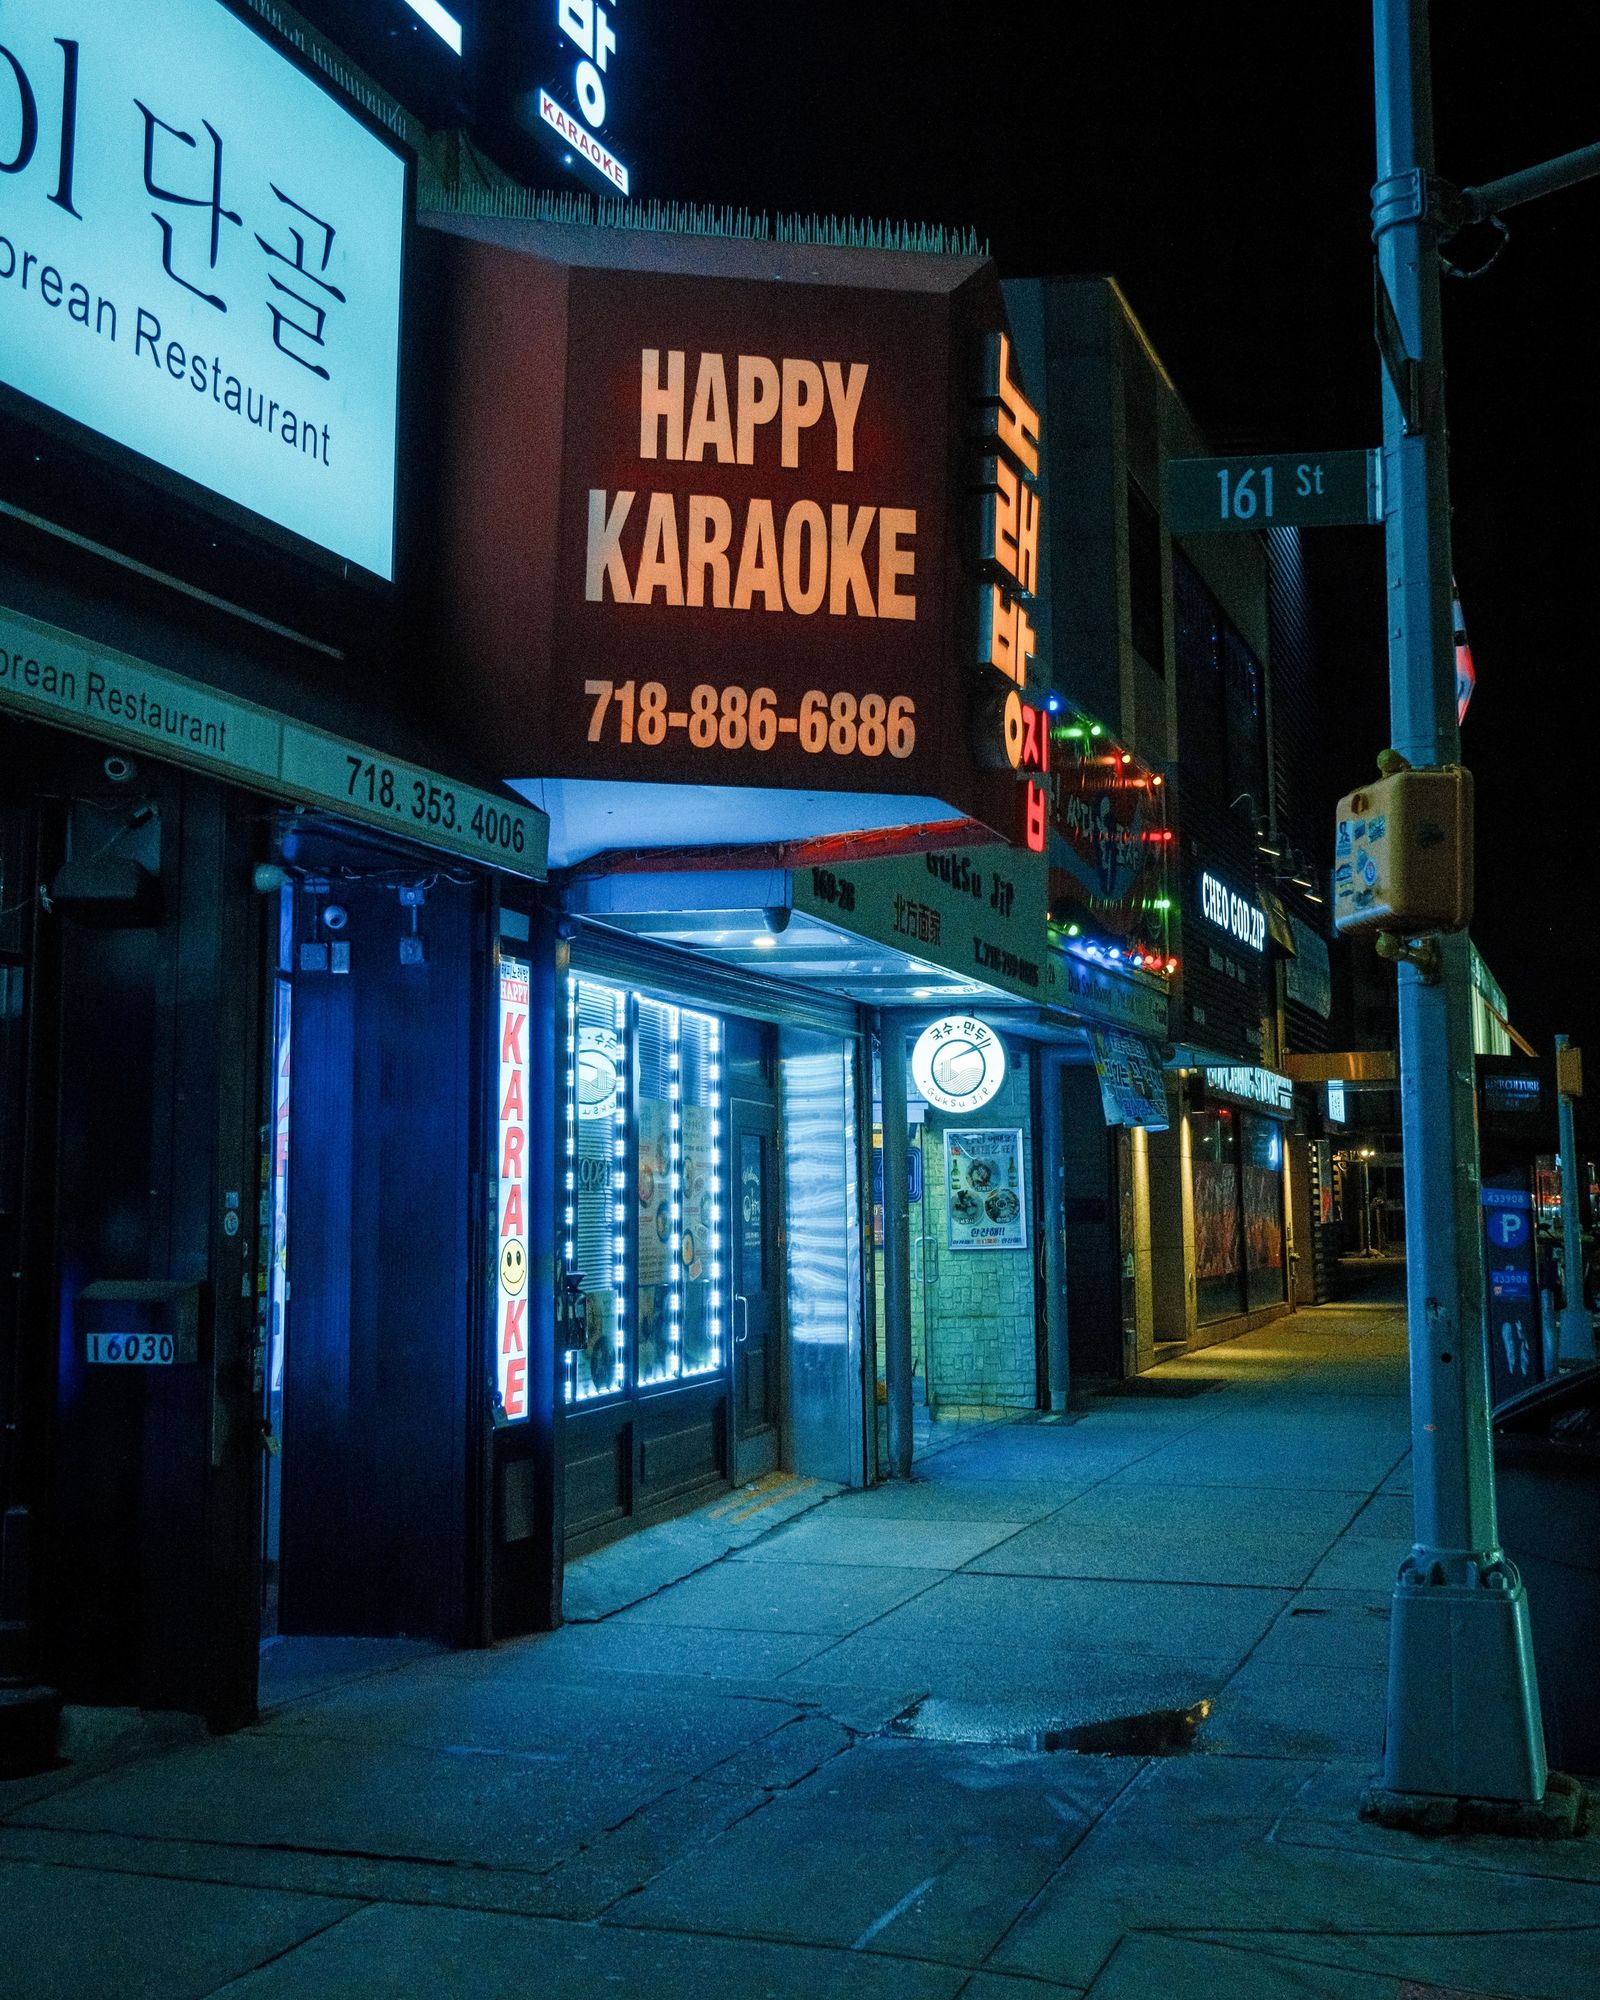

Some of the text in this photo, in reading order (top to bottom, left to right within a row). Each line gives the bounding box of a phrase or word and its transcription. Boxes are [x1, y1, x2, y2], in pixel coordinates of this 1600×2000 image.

[543, 97, 624, 187] KARAOKE
[133, 98, 347, 381] 단골
[135, 307, 332, 467] Restaurant
[640, 348, 869, 472] HAPPY
[1217, 464, 1325, 519] 161 St
[585, 489, 917, 621] KARAOKE
[88, 671, 227, 752] Restaurant
[584, 680, 917, 759] 718-886-6886
[346, 756, 525, 854] 718. 353. 4006
[1202, 871, 1229, 930] CHEO
[501, 980, 528, 1004] HAPPY
[930, 1020, 988, 1041] 국수 만두
[927, 1086, 989, 1108] GukSu Jip
[1501, 1213, 1521, 1243] P
[93, 1335, 173, 1362] 16030
